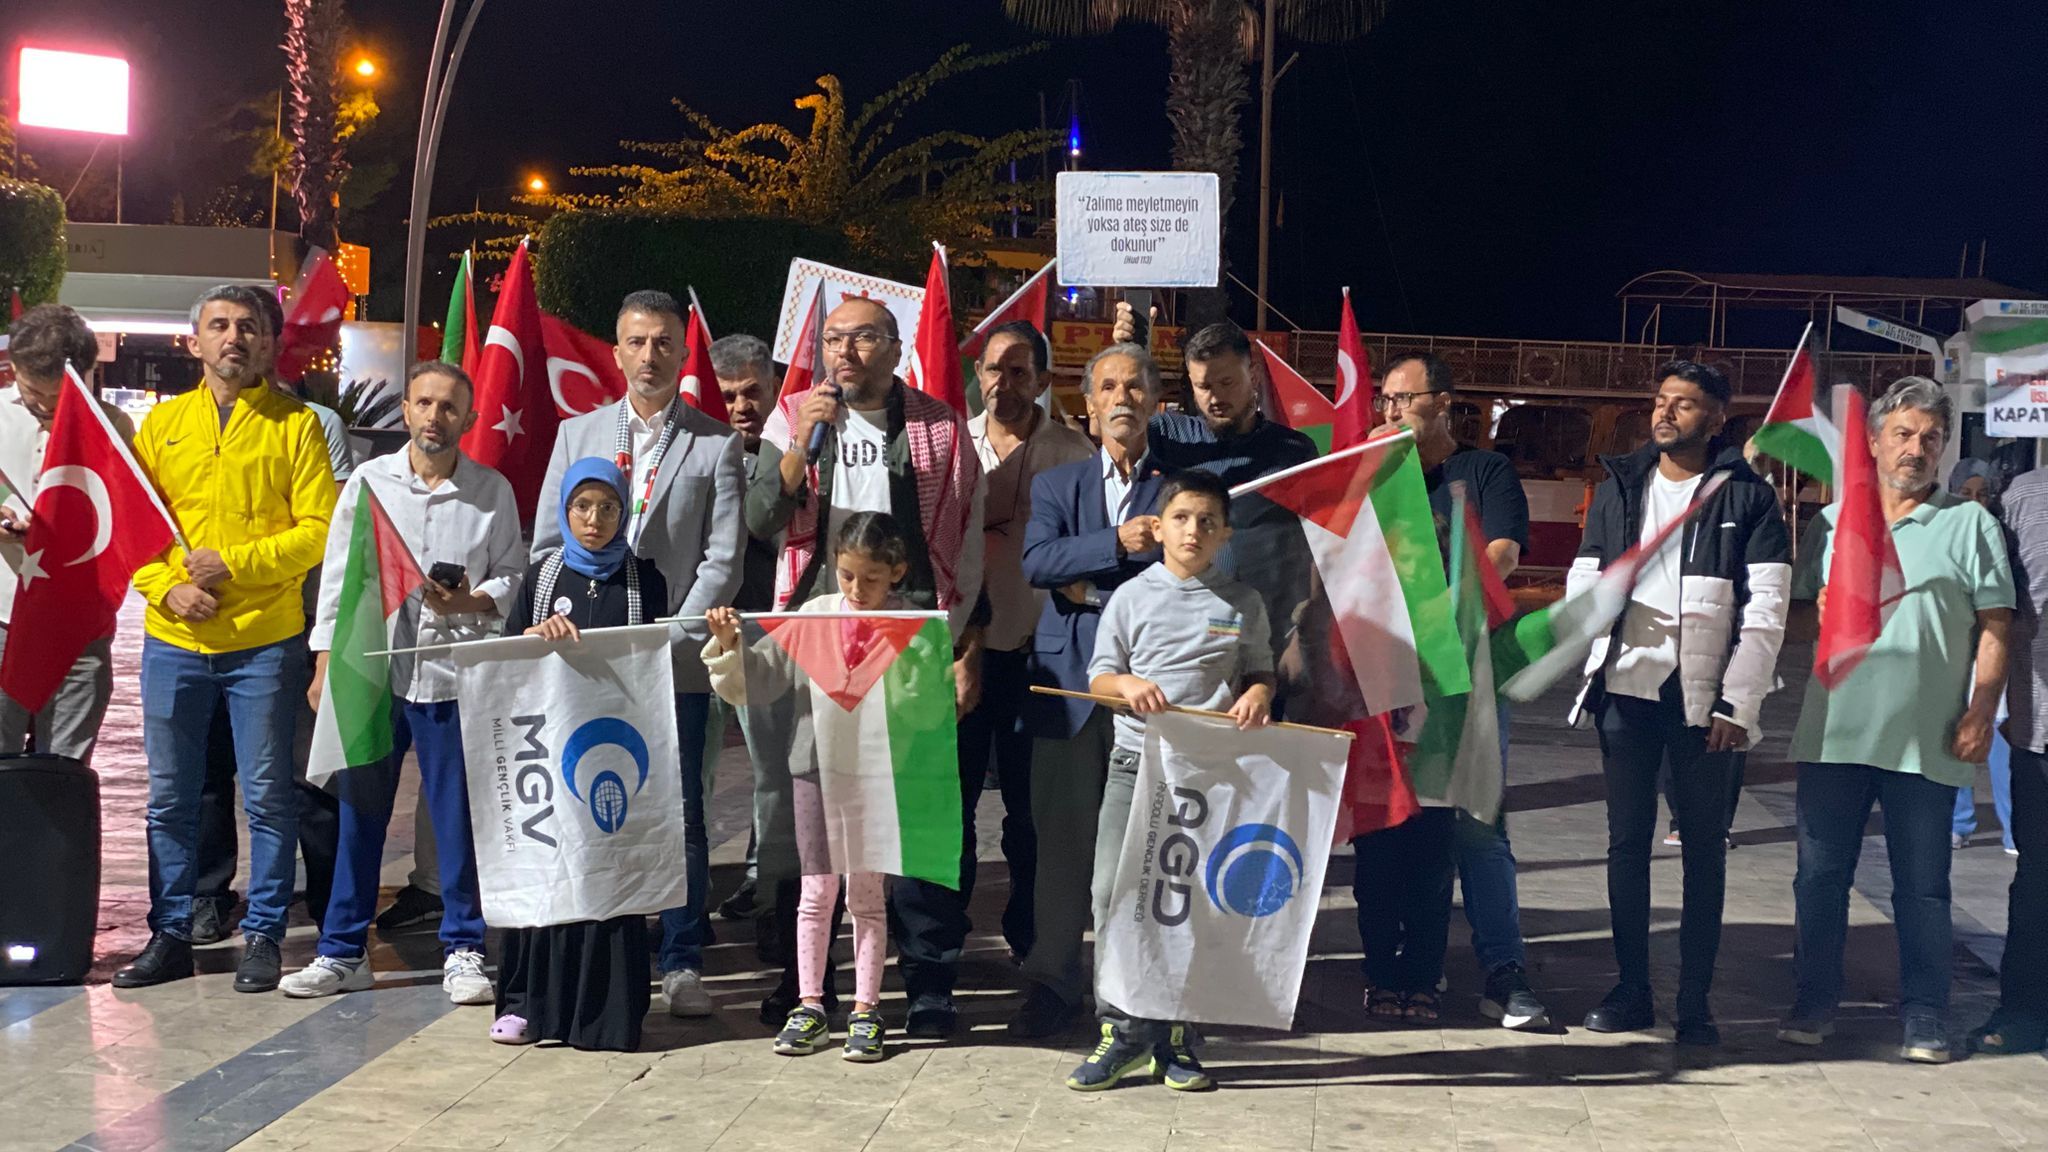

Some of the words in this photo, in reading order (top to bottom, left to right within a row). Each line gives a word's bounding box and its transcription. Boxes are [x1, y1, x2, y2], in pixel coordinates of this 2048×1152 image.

[1078, 195, 1123, 212] “Zalime
[1126, 196, 1199, 214] meyletmeyin
[1087, 216, 1120, 234] yoksa
[1123, 216, 1147, 237] ateş
[1150, 216, 1172, 233] size
[1174, 217, 1189, 232] de
[1110, 236, 1166, 253] dokunur”
[510, 714, 557, 848] MGV
[1152, 786, 1208, 926] AGD
